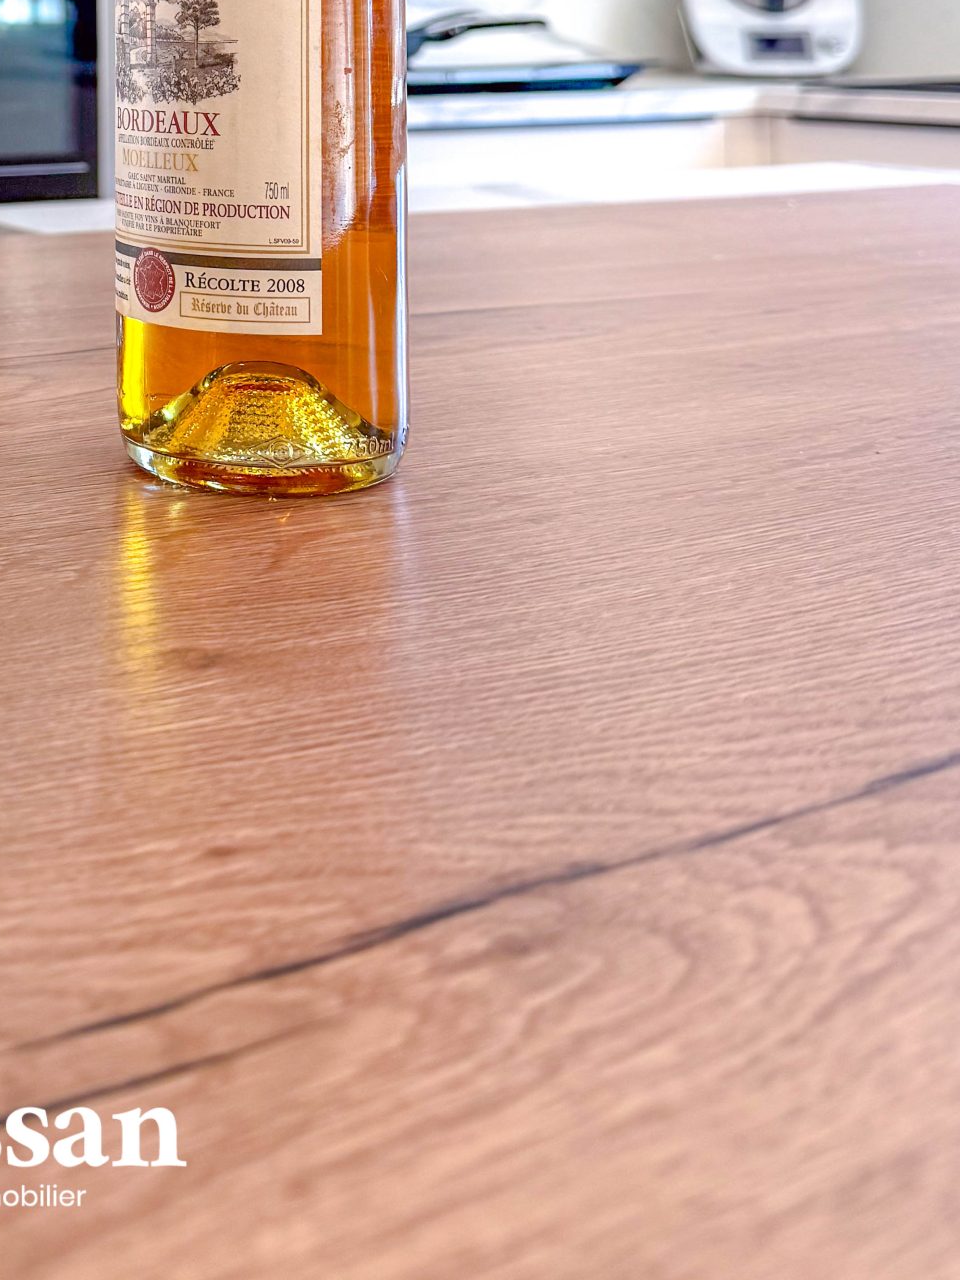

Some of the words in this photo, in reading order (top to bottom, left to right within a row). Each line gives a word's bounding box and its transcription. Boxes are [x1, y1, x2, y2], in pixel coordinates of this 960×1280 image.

[117, 107, 221, 137] BORDEAUX
[141, 136, 170, 147] BORDEAUX
[122, 148, 199, 172] MOELLEUX
[140, 173, 156, 183] SAINT
[157, 175, 187, 185] MARTIAL
[164, 185, 196, 196] GIRONDE
[203, 188, 235, 198] FRANCE
[265, 181, 279, 200] 750
[280, 181, 290, 200] ml
[134, 195, 144, 210] EN
[145, 194, 182, 215] RÉGION
[184, 201, 200, 216] DE
[202, 202, 291, 220] PRODUCTION
[145, 214, 159, 224] VINS
[165, 217, 221, 230] BLANQUEFORT
[145, 223, 154, 232] LE
[153, 225, 203, 237] PROPRIÉTAIRE
[184, 271, 261, 293] RÉCOLTE
[267, 278, 306, 293] 2008
[190, 297, 232, 316] Réserve
[237, 302, 249, 316] du
[253, 301, 299, 317] Château
